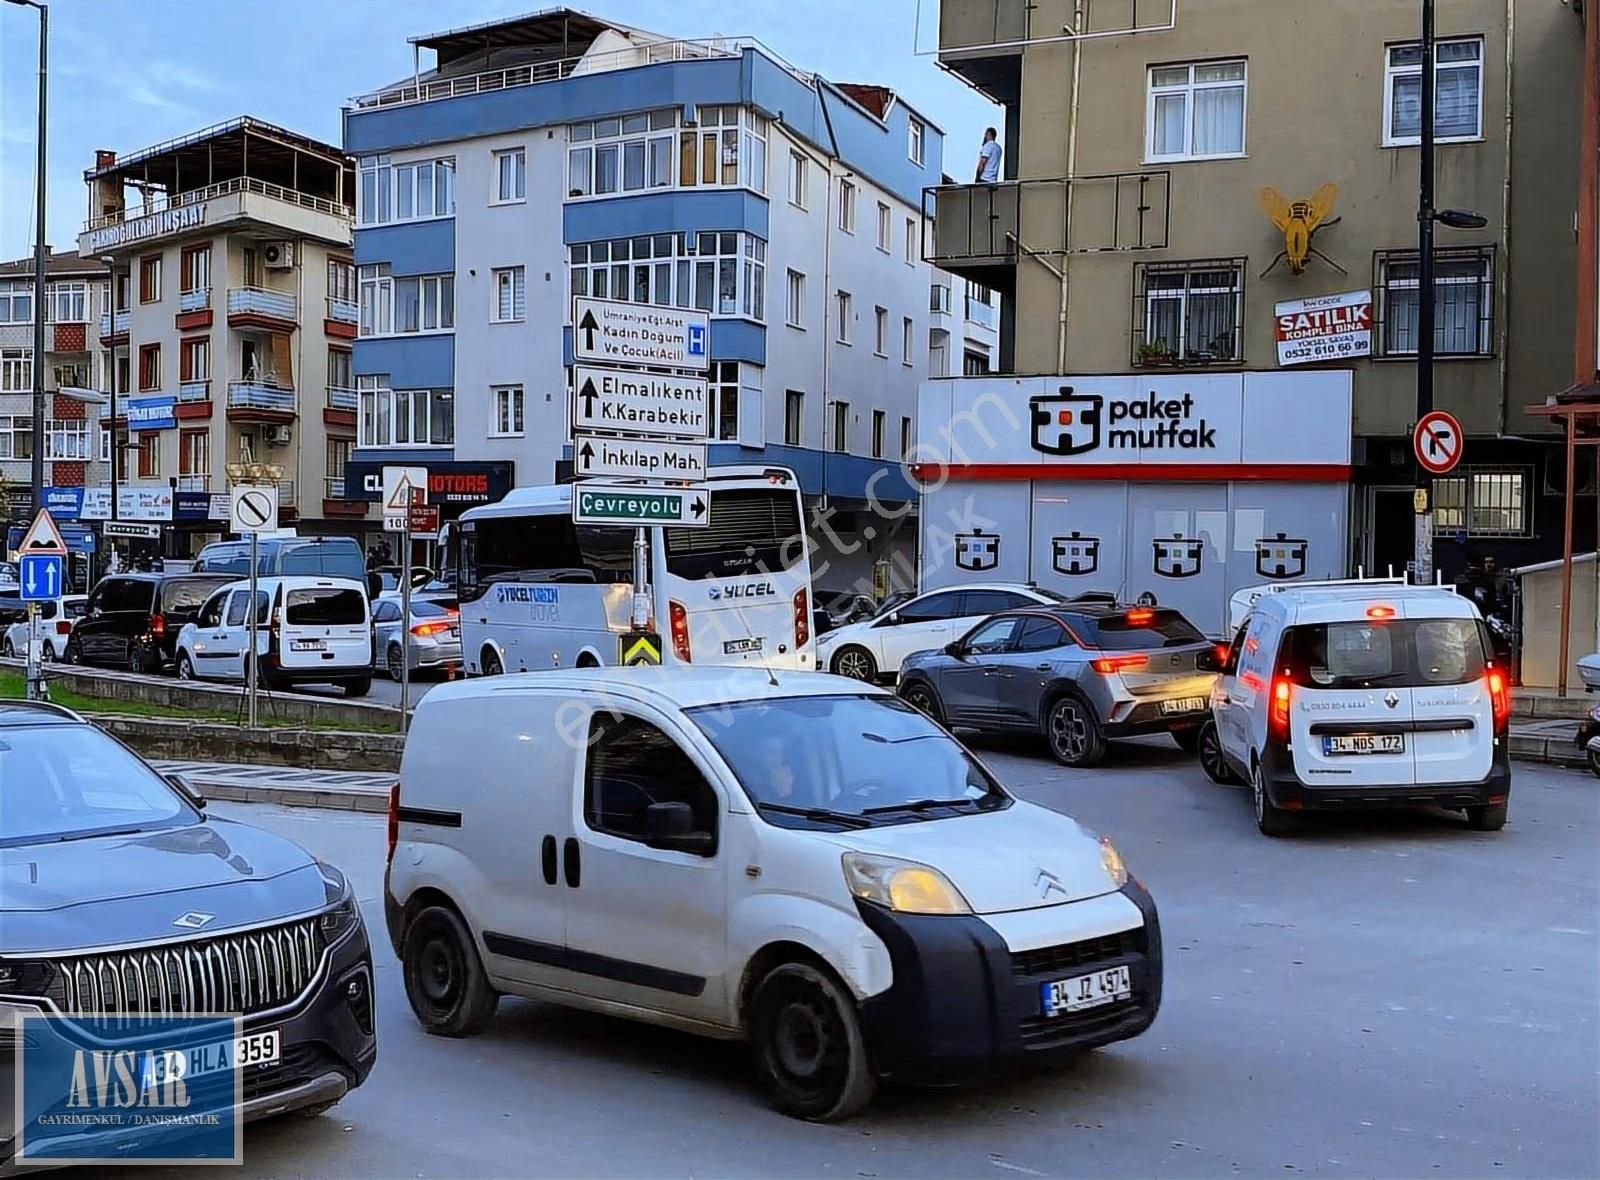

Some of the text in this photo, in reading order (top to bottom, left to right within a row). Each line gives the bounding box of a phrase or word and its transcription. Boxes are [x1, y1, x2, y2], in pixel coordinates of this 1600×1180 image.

[1280, 305, 1369, 331] SATILIK
[603, 325, 685, 344] Kadın Doğum
[1286, 322, 1364, 340] KOMPLE BİNA
[604, 342, 619, 354] Ve
[1284, 348, 1312, 359] 0532
[1314, 345, 1335, 355] 610
[1354, 340, 1369, 350] 99
[602, 376, 703, 401] Elmalıkent
[602, 402, 703, 427] K.Karabekir
[1109, 391, 1194, 425] paket
[1109, 419, 1216, 448] mutfak
[602, 443, 701, 472] İnkılap Mah.
[427, 475, 488, 492] OTORS
[581, 493, 680, 517] Çevreyolu
[1332, 738, 1346, 751] 34
[1382, 736, 1401, 749] 172
[1052, 968, 1129, 1007] 34 JZ 4974
[190, 1044, 229, 1075] HLA
[237, 1034, 275, 1065] 359
